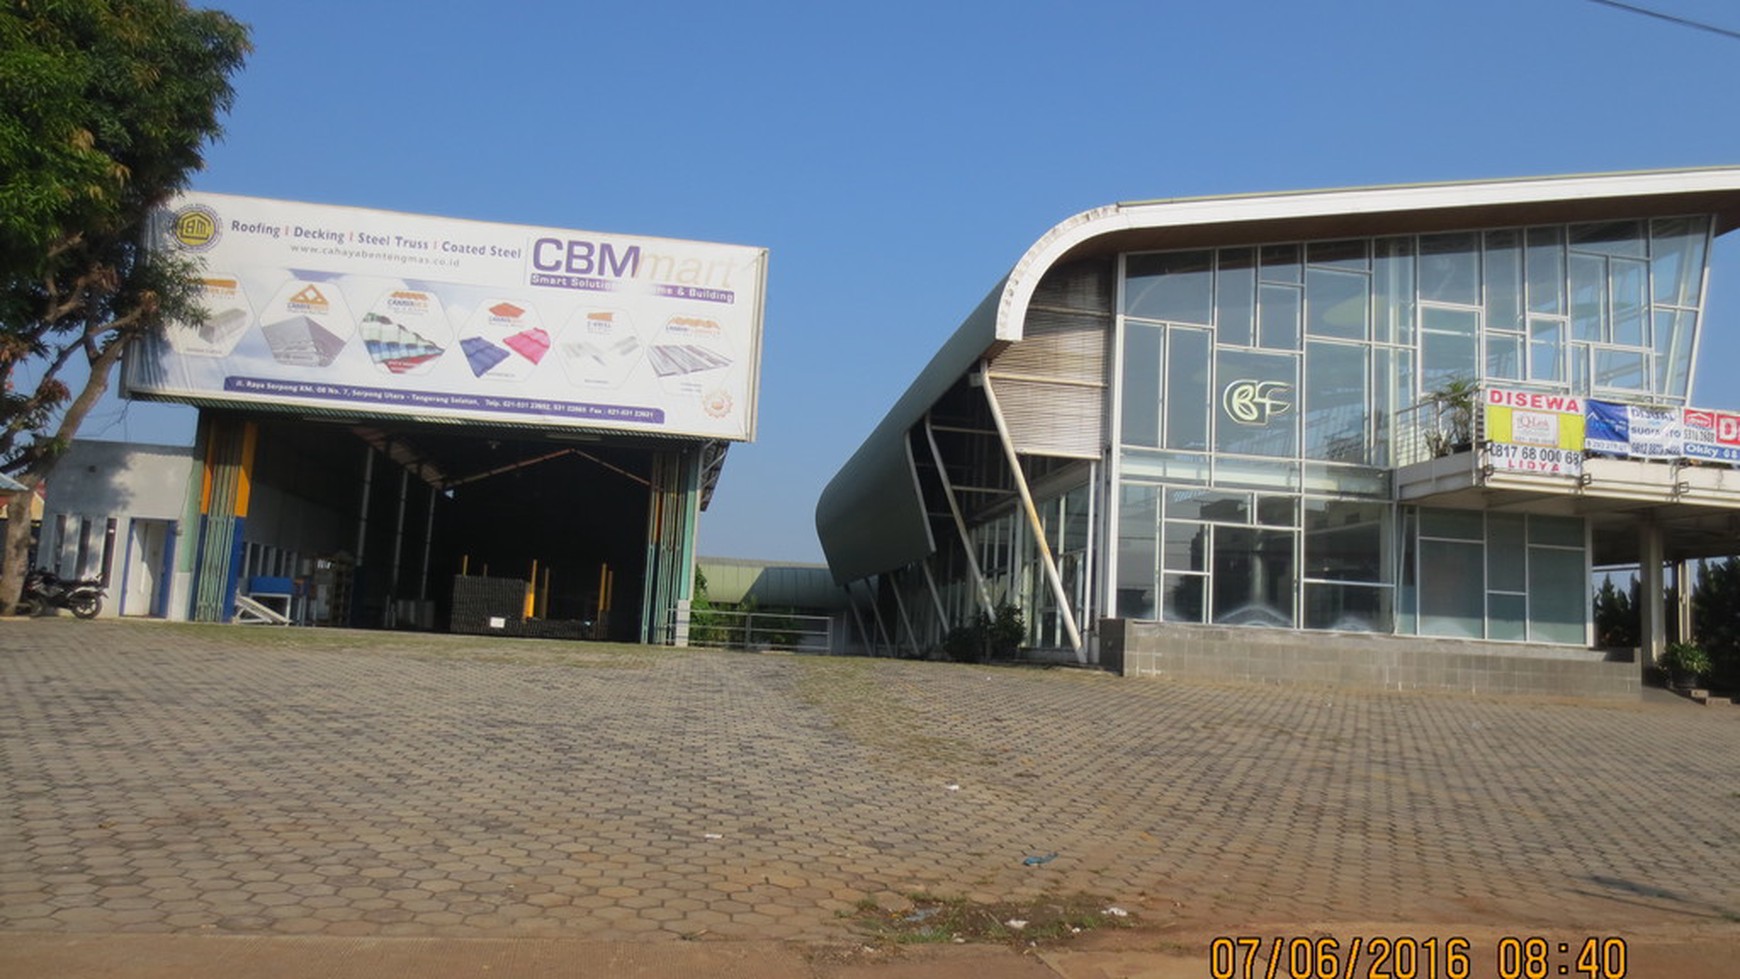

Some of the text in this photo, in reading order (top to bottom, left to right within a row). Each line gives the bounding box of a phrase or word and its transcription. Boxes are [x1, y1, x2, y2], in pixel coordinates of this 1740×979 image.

[231, 219, 522, 259] Roofing Decking Steel Truss Coated Steel
[290, 243, 460, 268] www.cahayabentengmas.co.id
[532, 273, 568, 286] Smart
[688, 288, 735, 304] Building
[352, 388, 382, 400] Serpong
[383, 390, 405, 401] Utara
[411, 393, 449, 404] Tangerang
[1490, 389, 1580, 413] DISEWA
[1508, 459, 1560, 472] LIDYA
[1521, 446, 1538, 460] 68
[1540, 448, 1562, 463] 000
